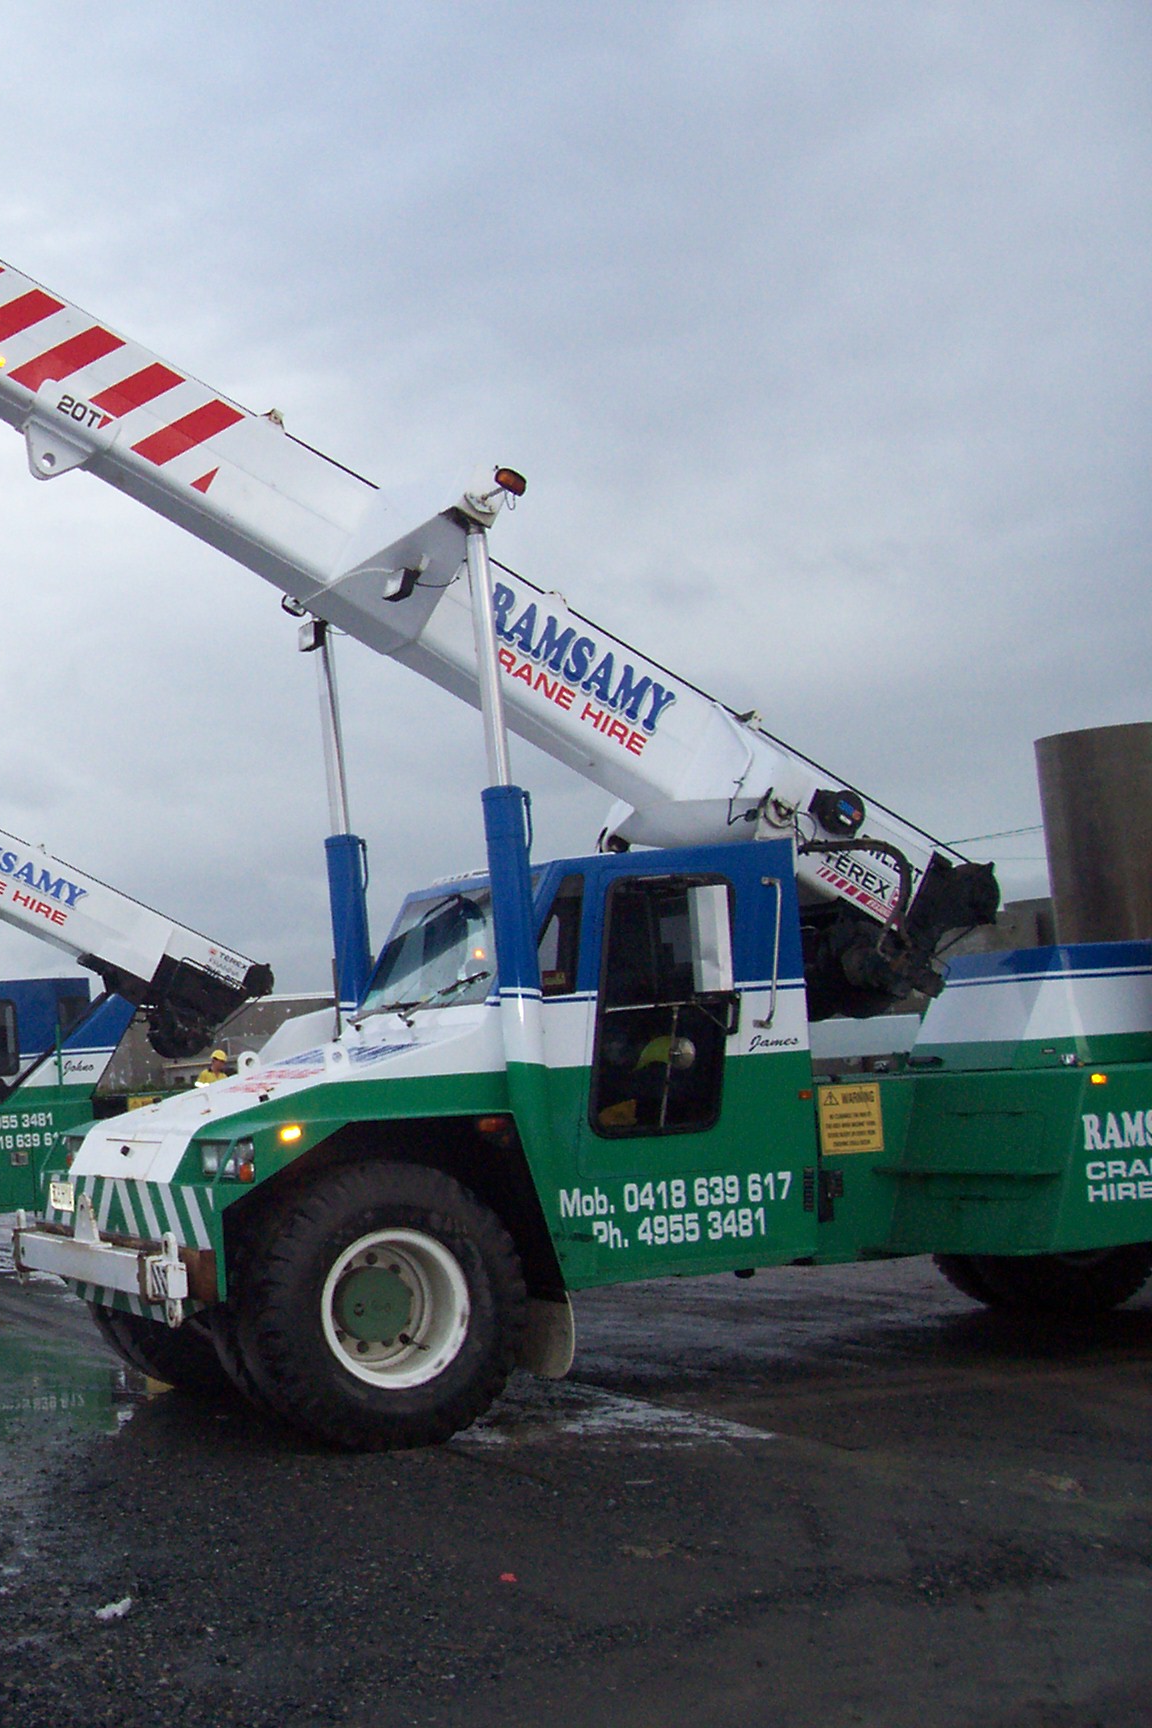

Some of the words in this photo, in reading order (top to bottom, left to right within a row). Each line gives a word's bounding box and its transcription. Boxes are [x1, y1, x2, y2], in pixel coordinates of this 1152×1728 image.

[56, 394, 102, 428] 20T
[492, 582, 676, 733] RAMSAMY
[498, 648, 576, 711] RANE
[580, 702, 648, 756] HIRE
[12, 890, 68, 926] HIRE
[748, 1034, 798, 1052] James
[21, 1112, 53, 1127] 3481
[16, 1133, 40, 1148] 639
[1086, 1158, 1152, 1180] CRA
[559, 1186, 615, 1218] Mob.
[624, 1179, 687, 1213] 0418
[694, 1175, 740, 1207] 639
[748, 1171, 792, 1202] 617
[1088, 1181, 1152, 1203] HIRE
[592, 1220, 629, 1249] Ph.
[637, 1213, 700, 1246] 4955
[707, 1207, 766, 1240] 3481
